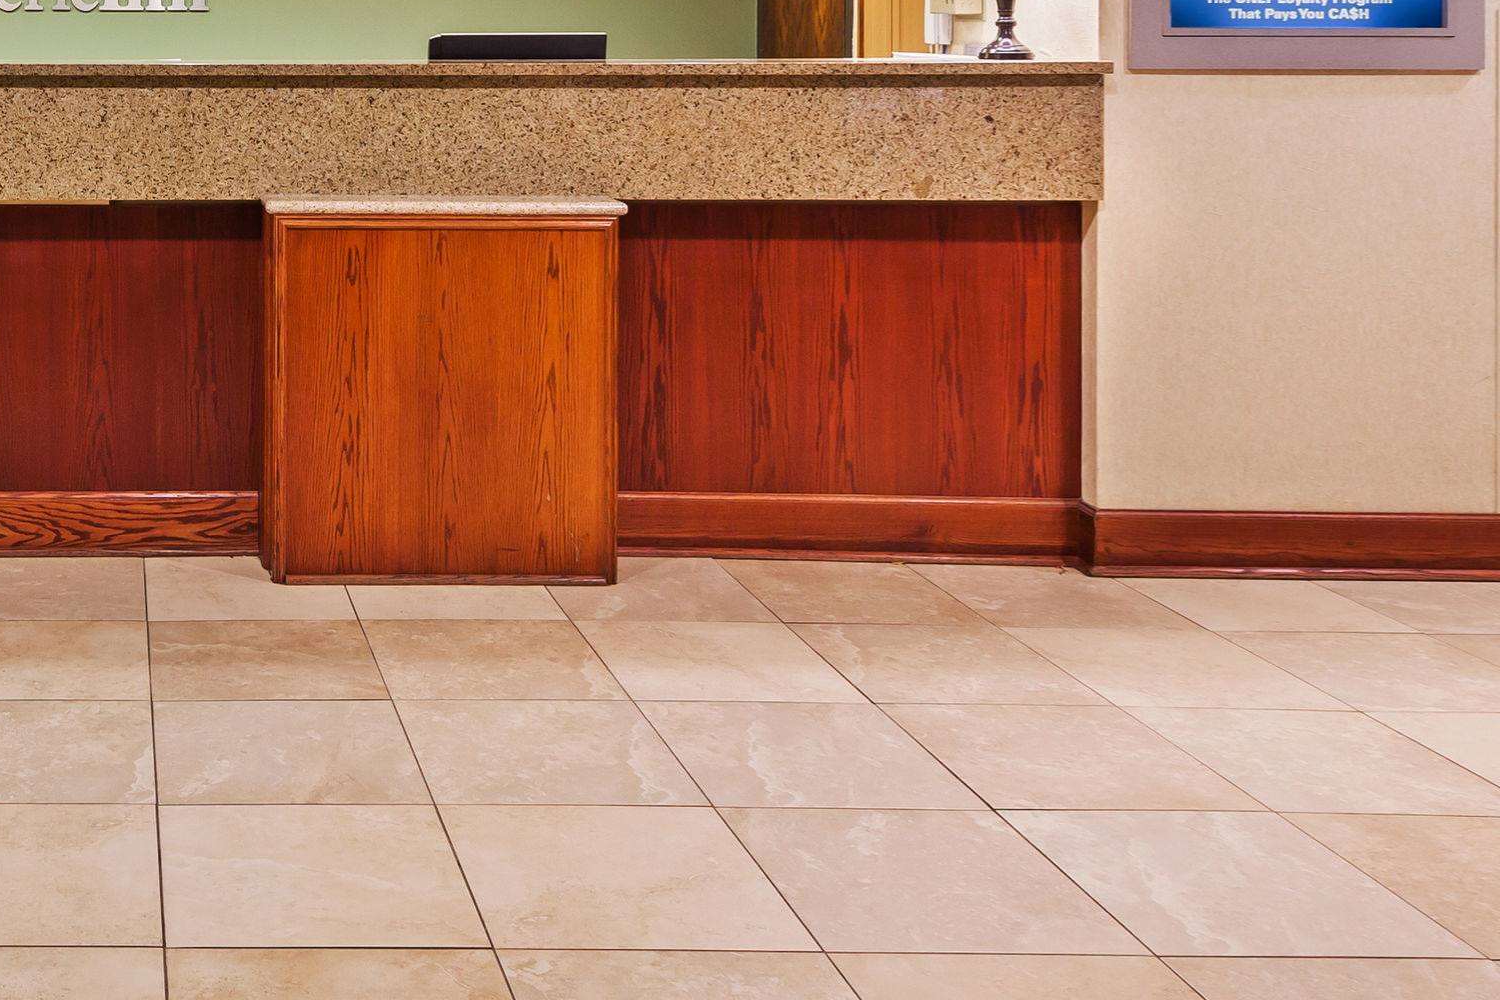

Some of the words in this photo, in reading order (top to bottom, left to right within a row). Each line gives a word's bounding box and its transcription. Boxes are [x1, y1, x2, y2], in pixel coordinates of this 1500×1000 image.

[1229, 8, 1261, 19] That
[1265, 8, 1297, 21] Pays
[1298, 8, 1325, 20] You
[1328, 7, 1370, 21] CA$H
